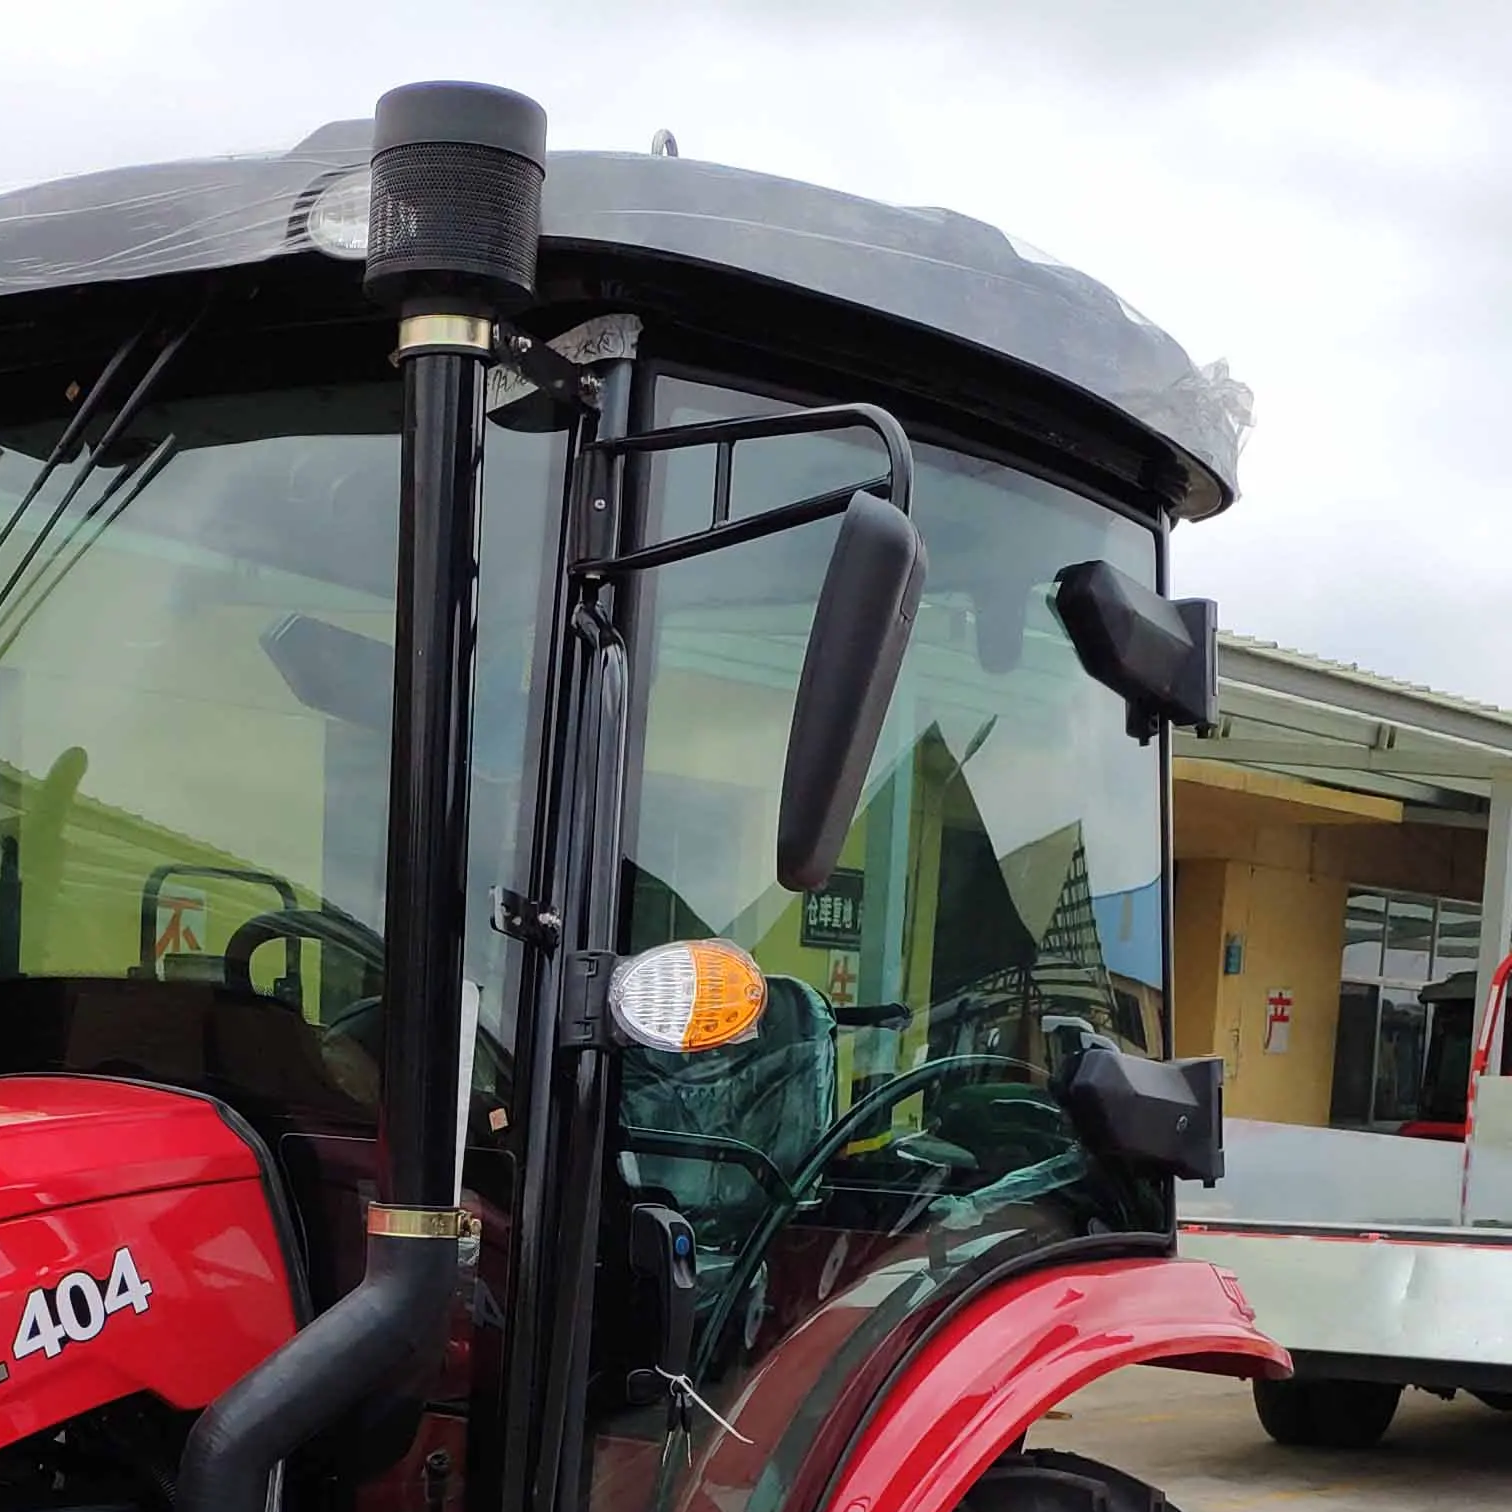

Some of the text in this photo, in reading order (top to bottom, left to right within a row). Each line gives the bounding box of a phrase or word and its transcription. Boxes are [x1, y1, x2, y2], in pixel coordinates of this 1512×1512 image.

[830, 956, 857, 1003] 生
[1264, 992, 1292, 1050] 产
[12, 1246, 153, 1360] 404
